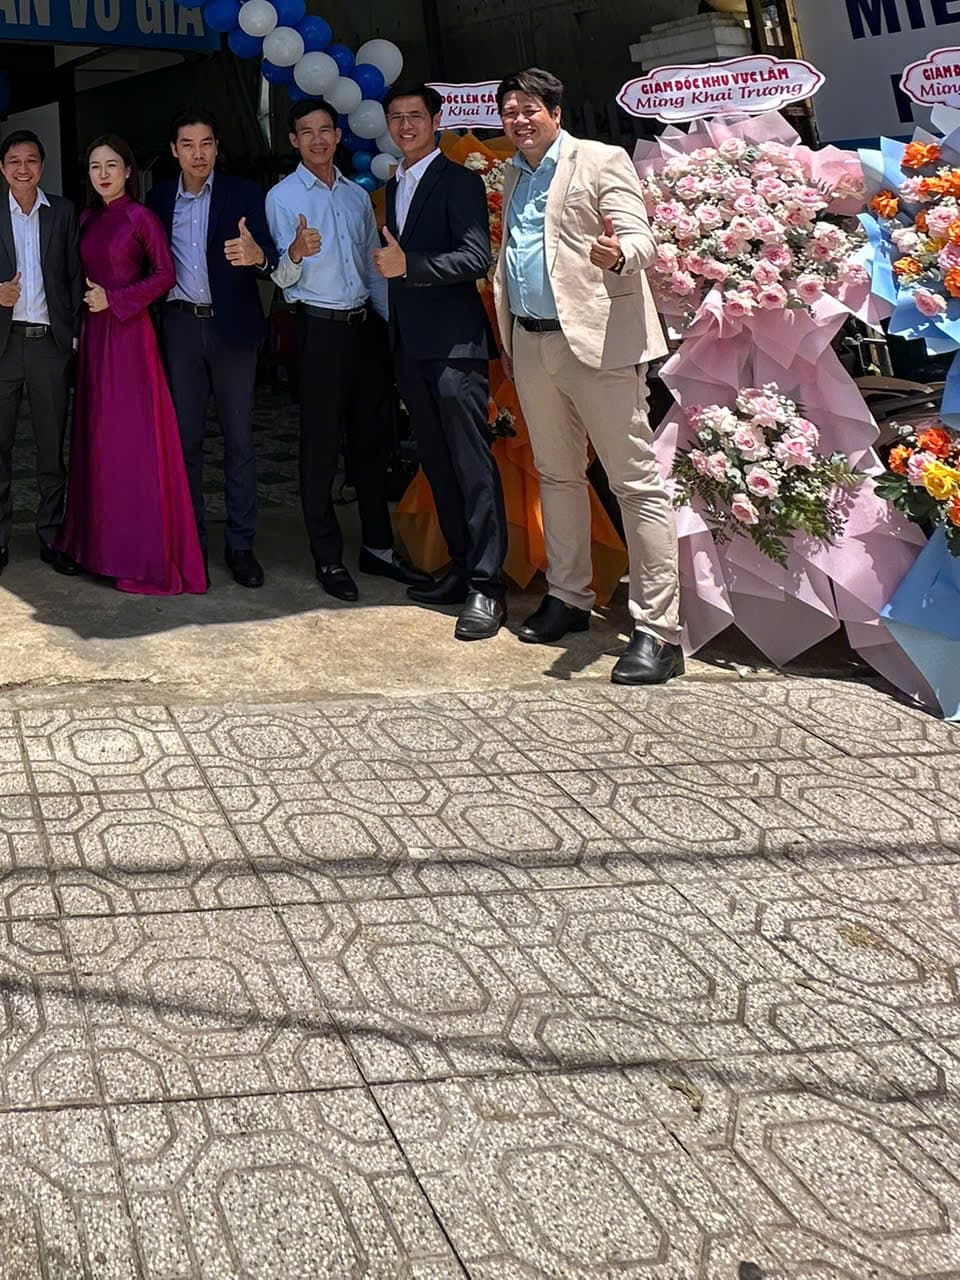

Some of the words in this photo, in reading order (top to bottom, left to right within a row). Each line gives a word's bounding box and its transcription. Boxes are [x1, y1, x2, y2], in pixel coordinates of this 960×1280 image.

[701, 74, 729, 89] KHU
[692, 88, 733, 105] Khai
[738, 83, 804, 99] Trương
[448, 105, 480, 117] Khai
